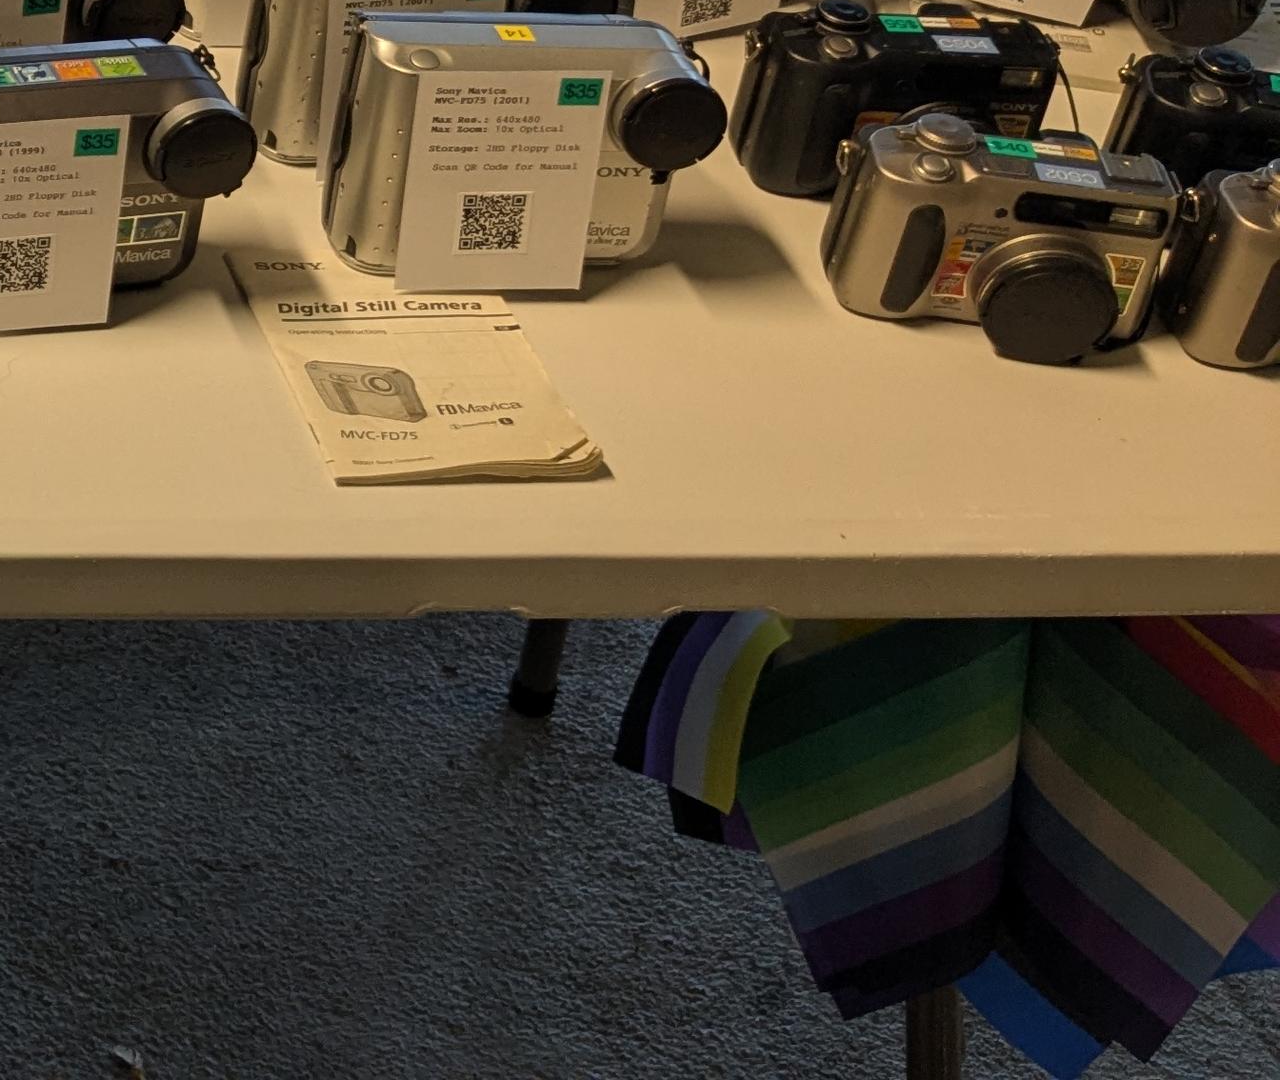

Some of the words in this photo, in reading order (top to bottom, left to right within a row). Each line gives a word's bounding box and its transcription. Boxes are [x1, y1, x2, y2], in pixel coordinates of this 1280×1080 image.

[436, 88, 462, 96] Sony
[563, 82, 598, 101] $35
[434, 96, 486, 104] MVC-FD75
[494, 97, 529, 105] (2001)
[80, 133, 114, 151] $35
[990, 139, 1029, 153] $40
[596, 165, 647, 180] ONY
[120, 192, 180, 208] SONY
[114, 246, 171, 264] Mavica
[254, 261, 322, 271] SONY
[278, 300, 349, 318] Digital
[356, 299, 396, 313] Still
[405, 298, 482, 312] Camera
[340, 429, 419, 441] MVC-FD75
